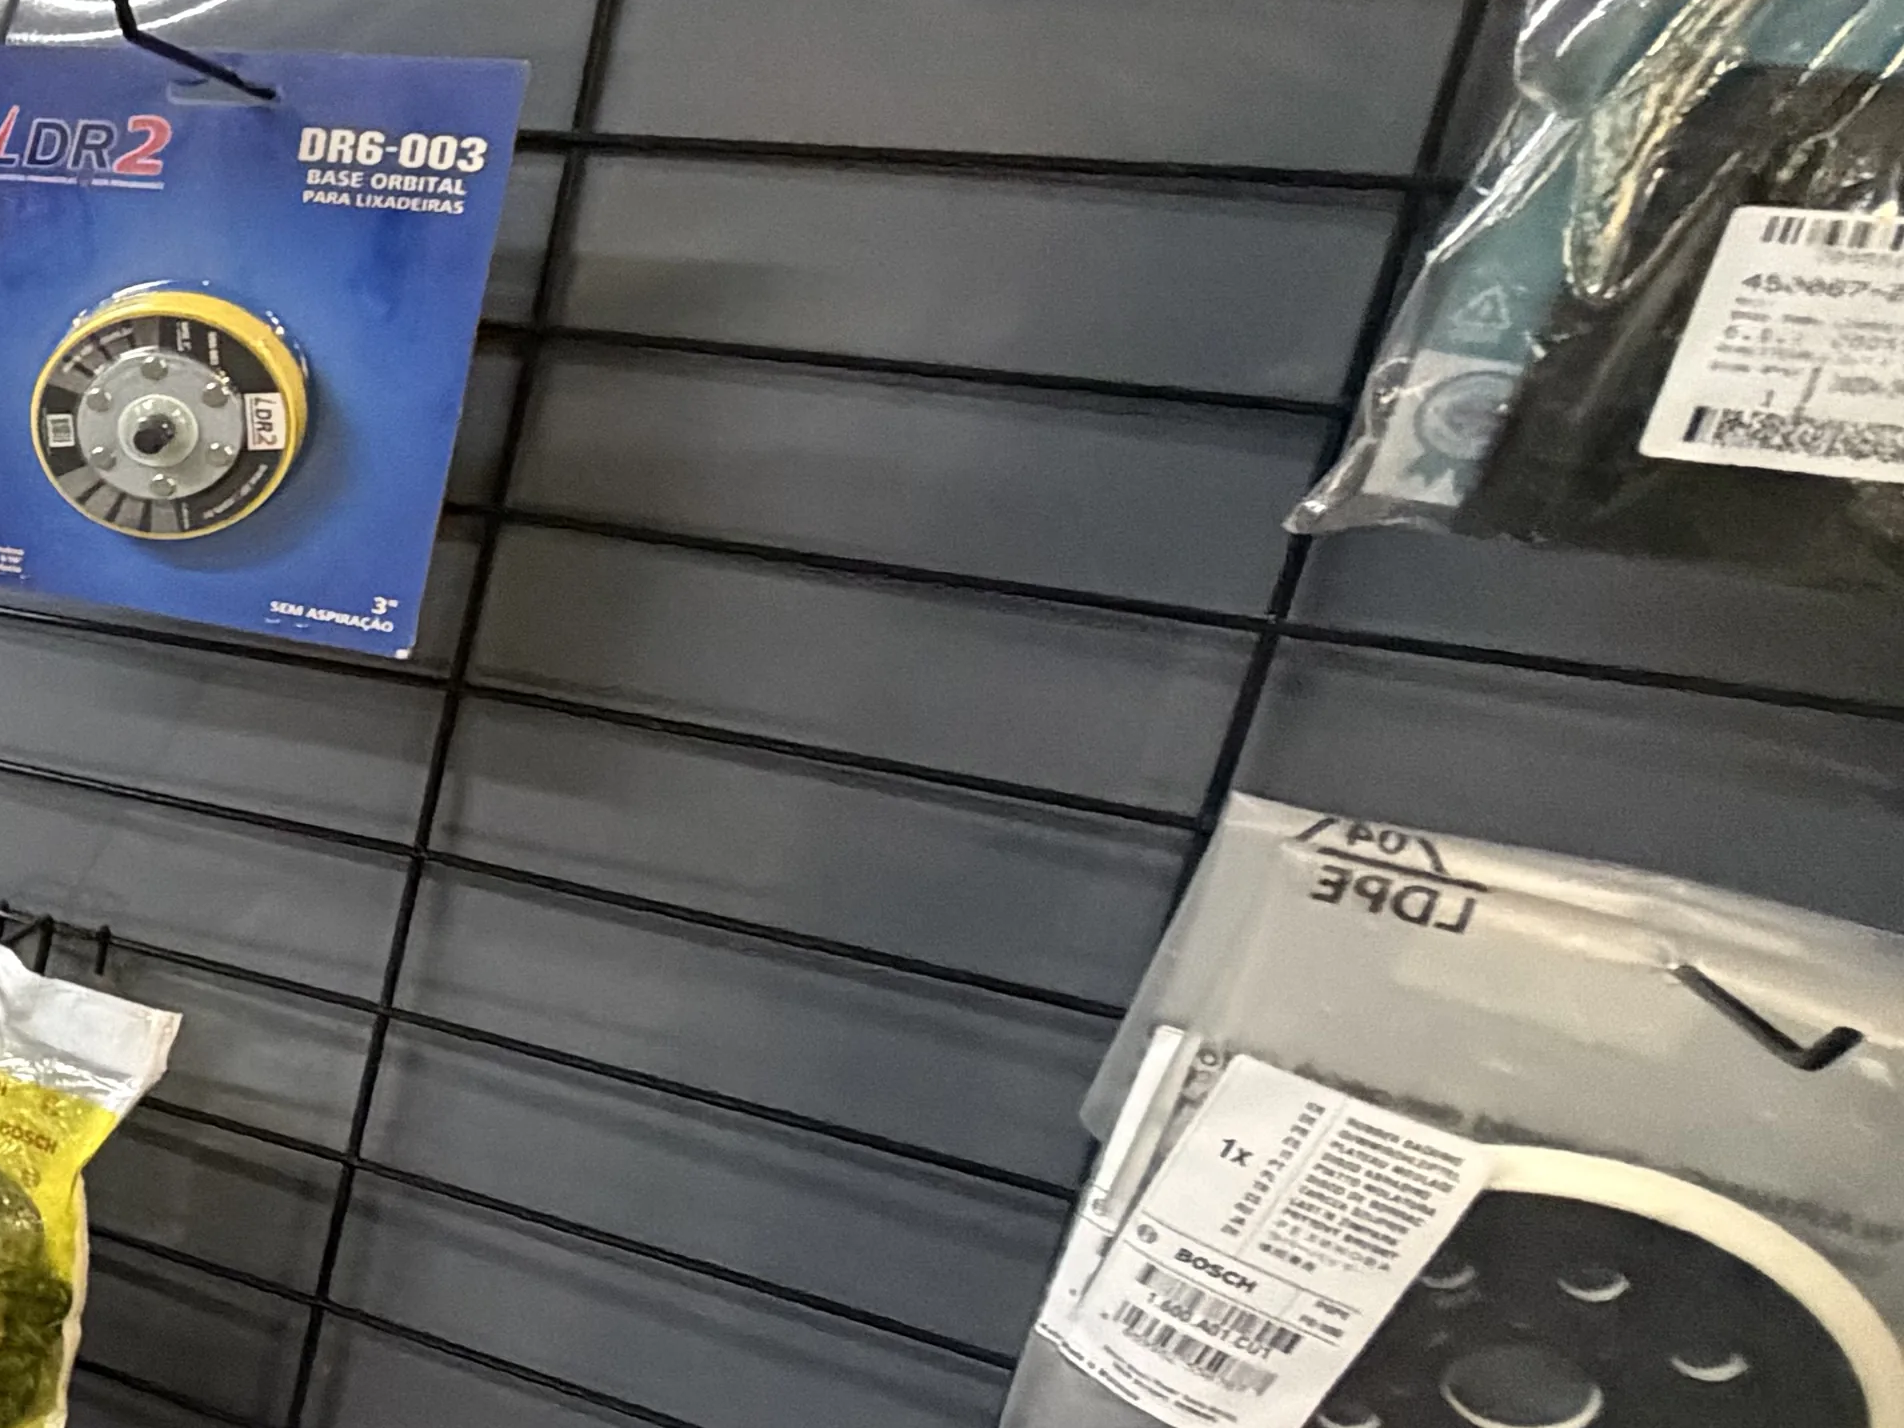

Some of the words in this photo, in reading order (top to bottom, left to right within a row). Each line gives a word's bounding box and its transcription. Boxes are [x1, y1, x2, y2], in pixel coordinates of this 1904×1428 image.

[298, 127, 488, 173] DR6-003
[307, 170, 364, 189] BASE
[370, 172, 468, 196] ORBITAL
[302, 189, 351, 207] PARA
[356, 192, 465, 215] LIXADEIRAS
[270, 600, 304, 616] SEM
[305, 607, 394, 632] ASPIRAÇÃO
[1219, 1137, 1254, 1168] 1x
[1173, 1247, 1258, 1294] BOSCH
